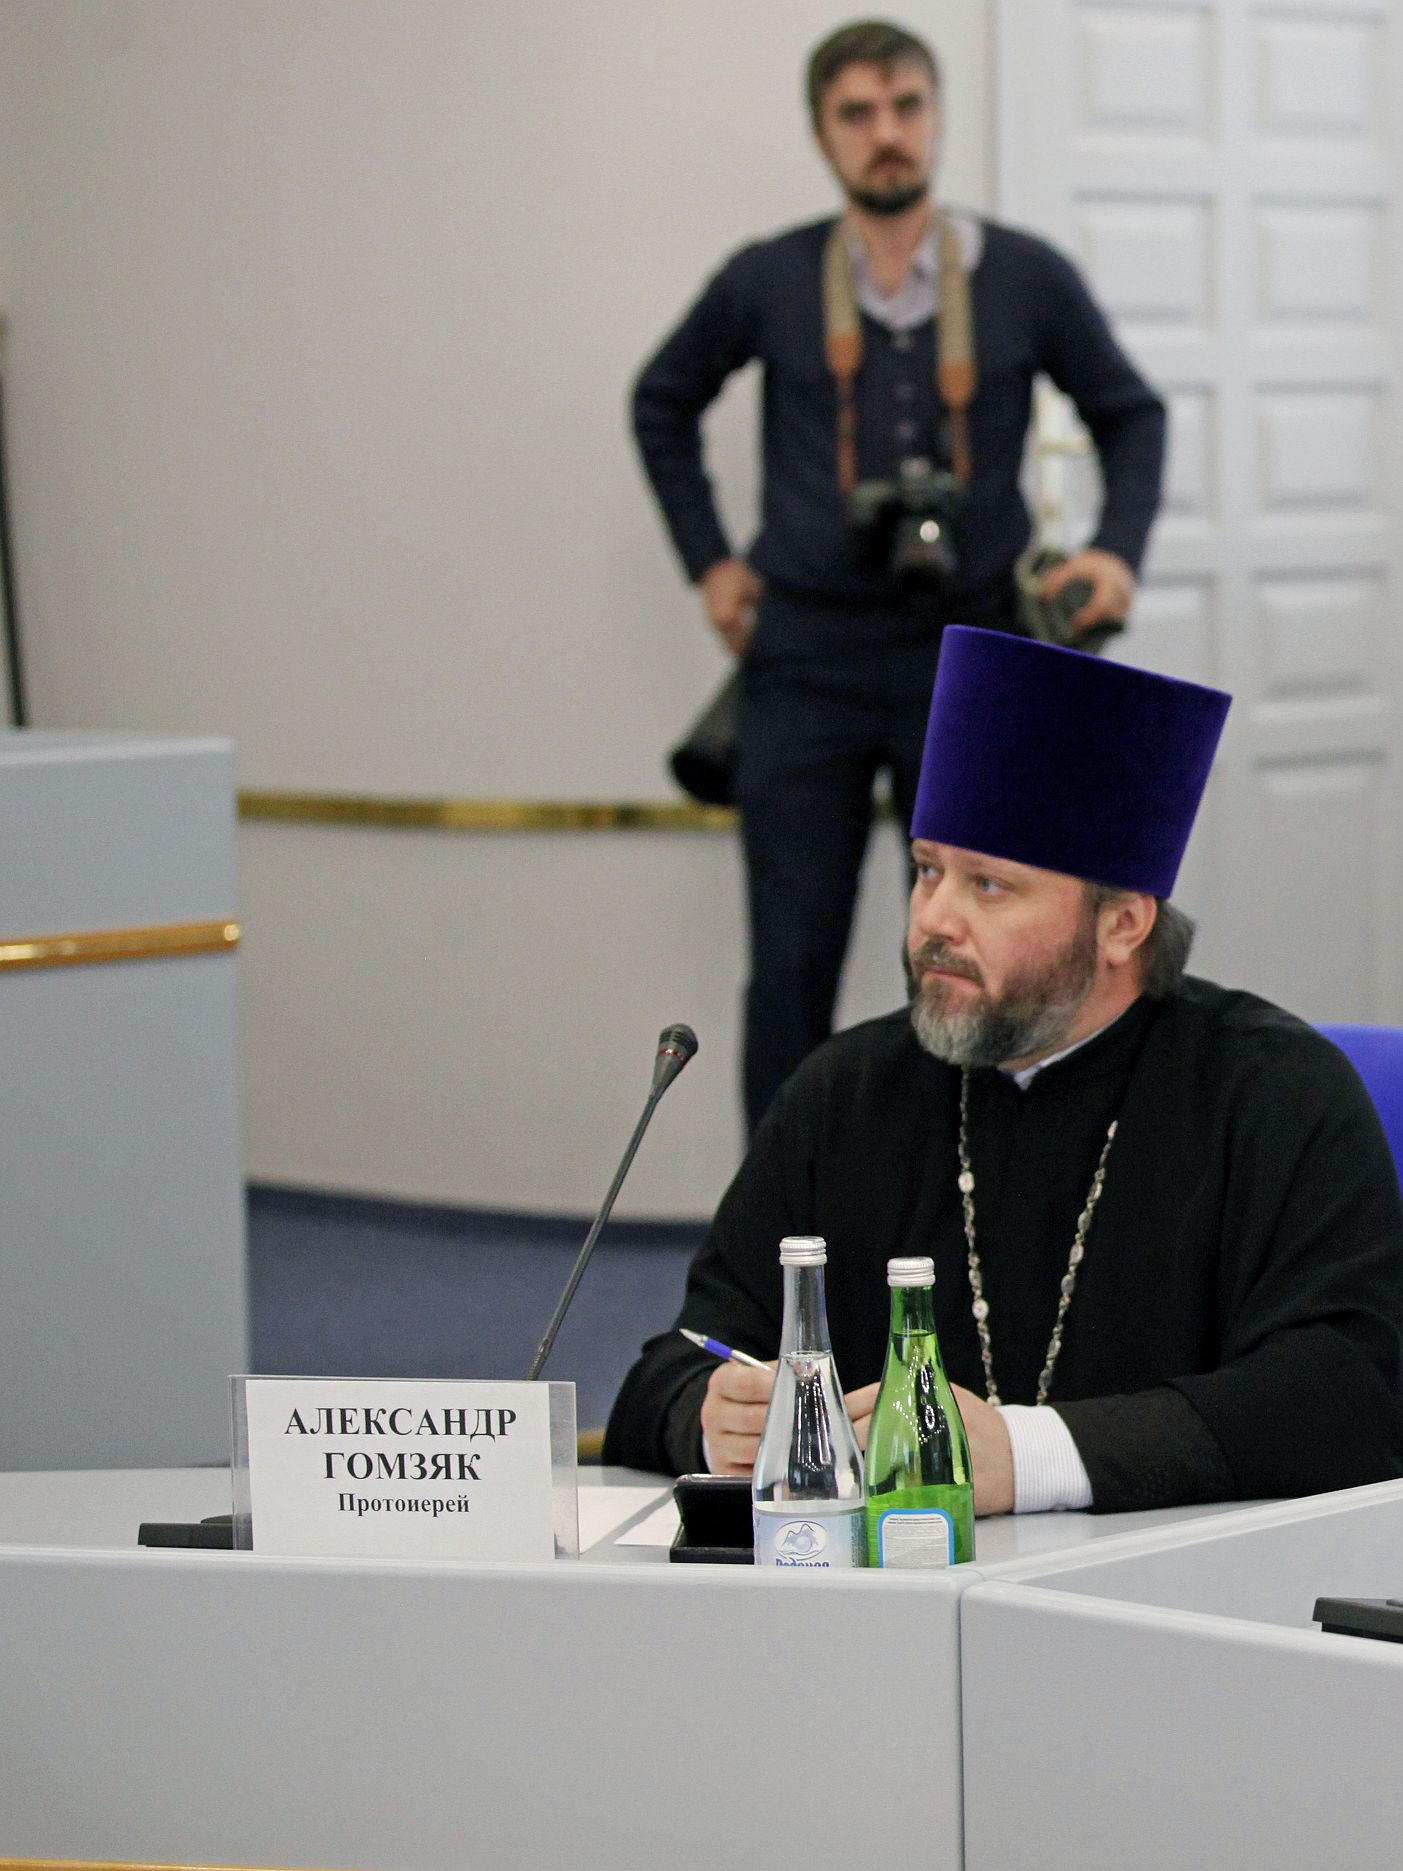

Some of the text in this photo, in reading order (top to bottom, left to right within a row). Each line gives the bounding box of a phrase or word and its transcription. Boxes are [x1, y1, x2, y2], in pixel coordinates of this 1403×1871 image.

[284, 1407, 517, 1442] АЛЕКСАНДР
[322, 1452, 481, 1481] ГОМЗЯК
[338, 1493, 470, 1517] Протоиерей
